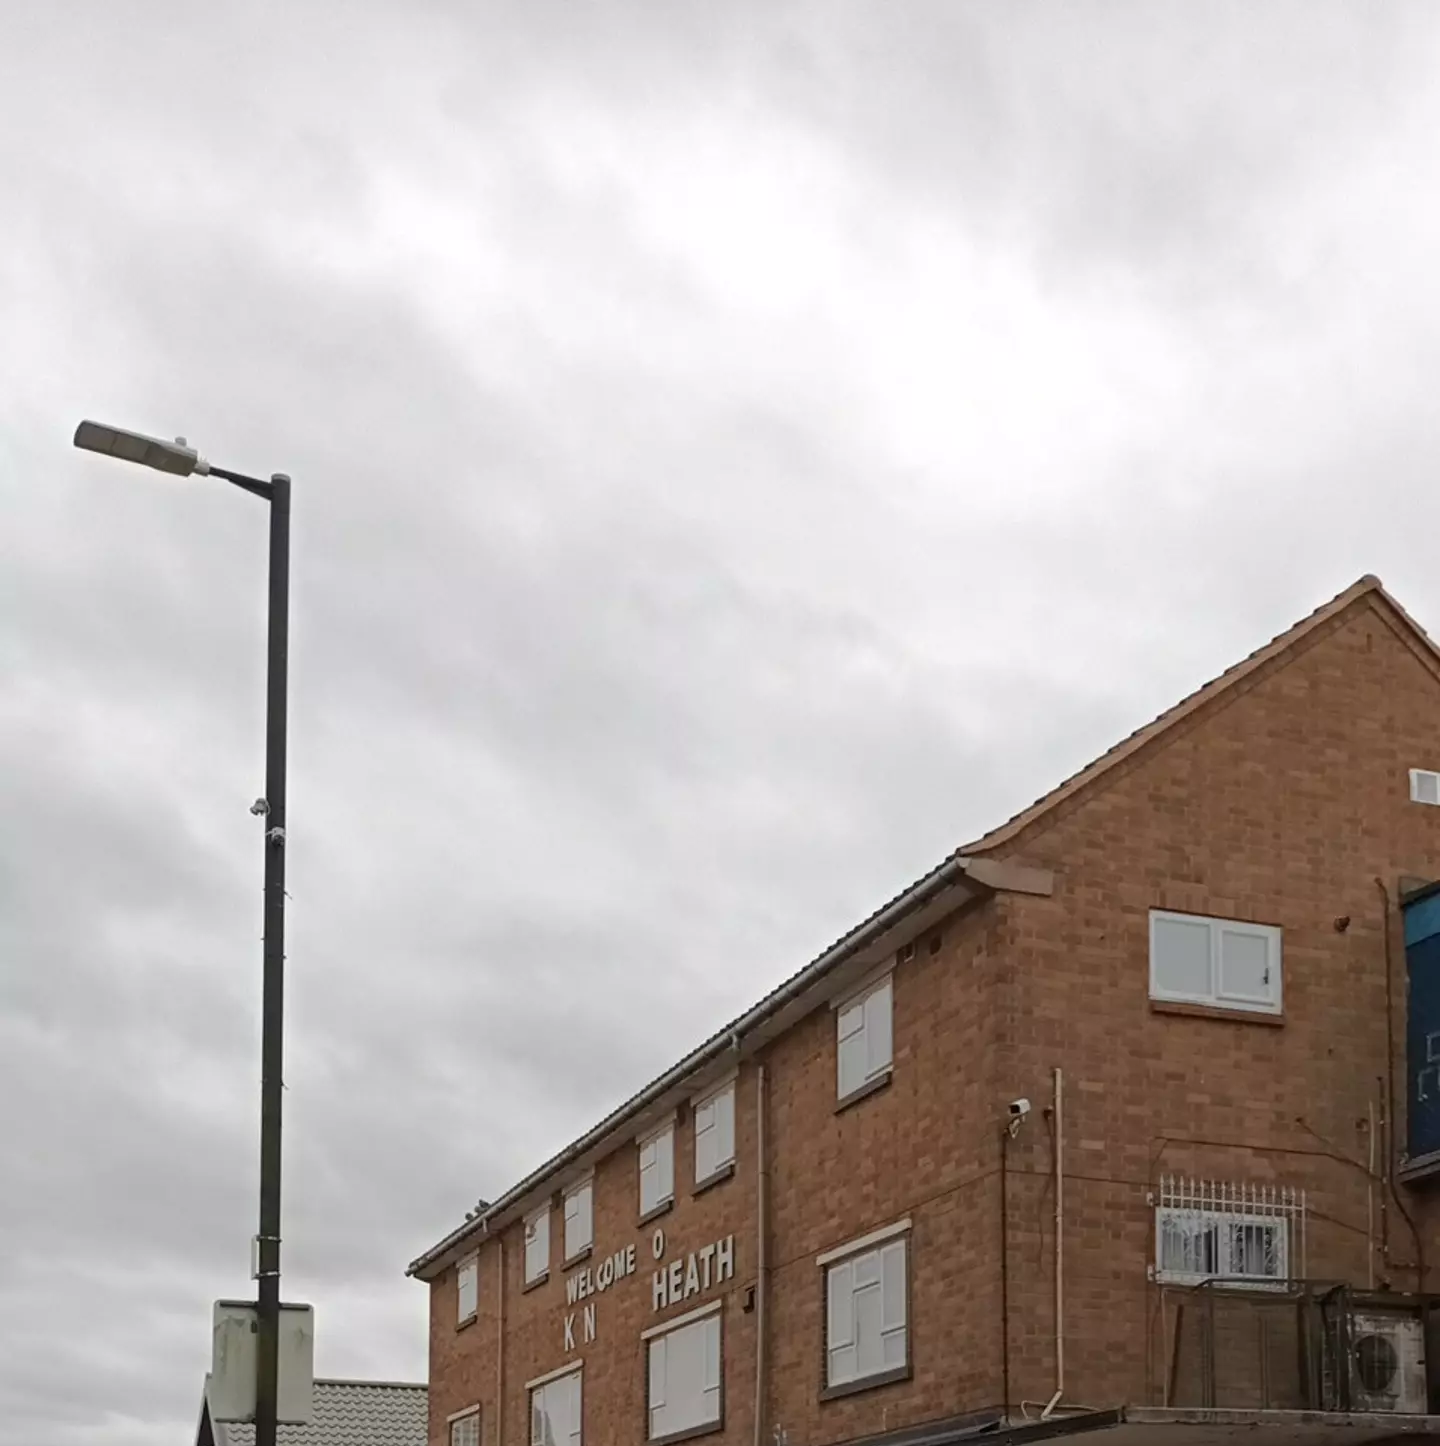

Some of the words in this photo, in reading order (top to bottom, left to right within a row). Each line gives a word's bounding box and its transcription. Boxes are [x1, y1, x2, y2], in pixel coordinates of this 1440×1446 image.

[566, 1244, 637, 1306] WELCOME
[652, 1229, 664, 1260] O
[652, 1234, 734, 1312] HEATH
